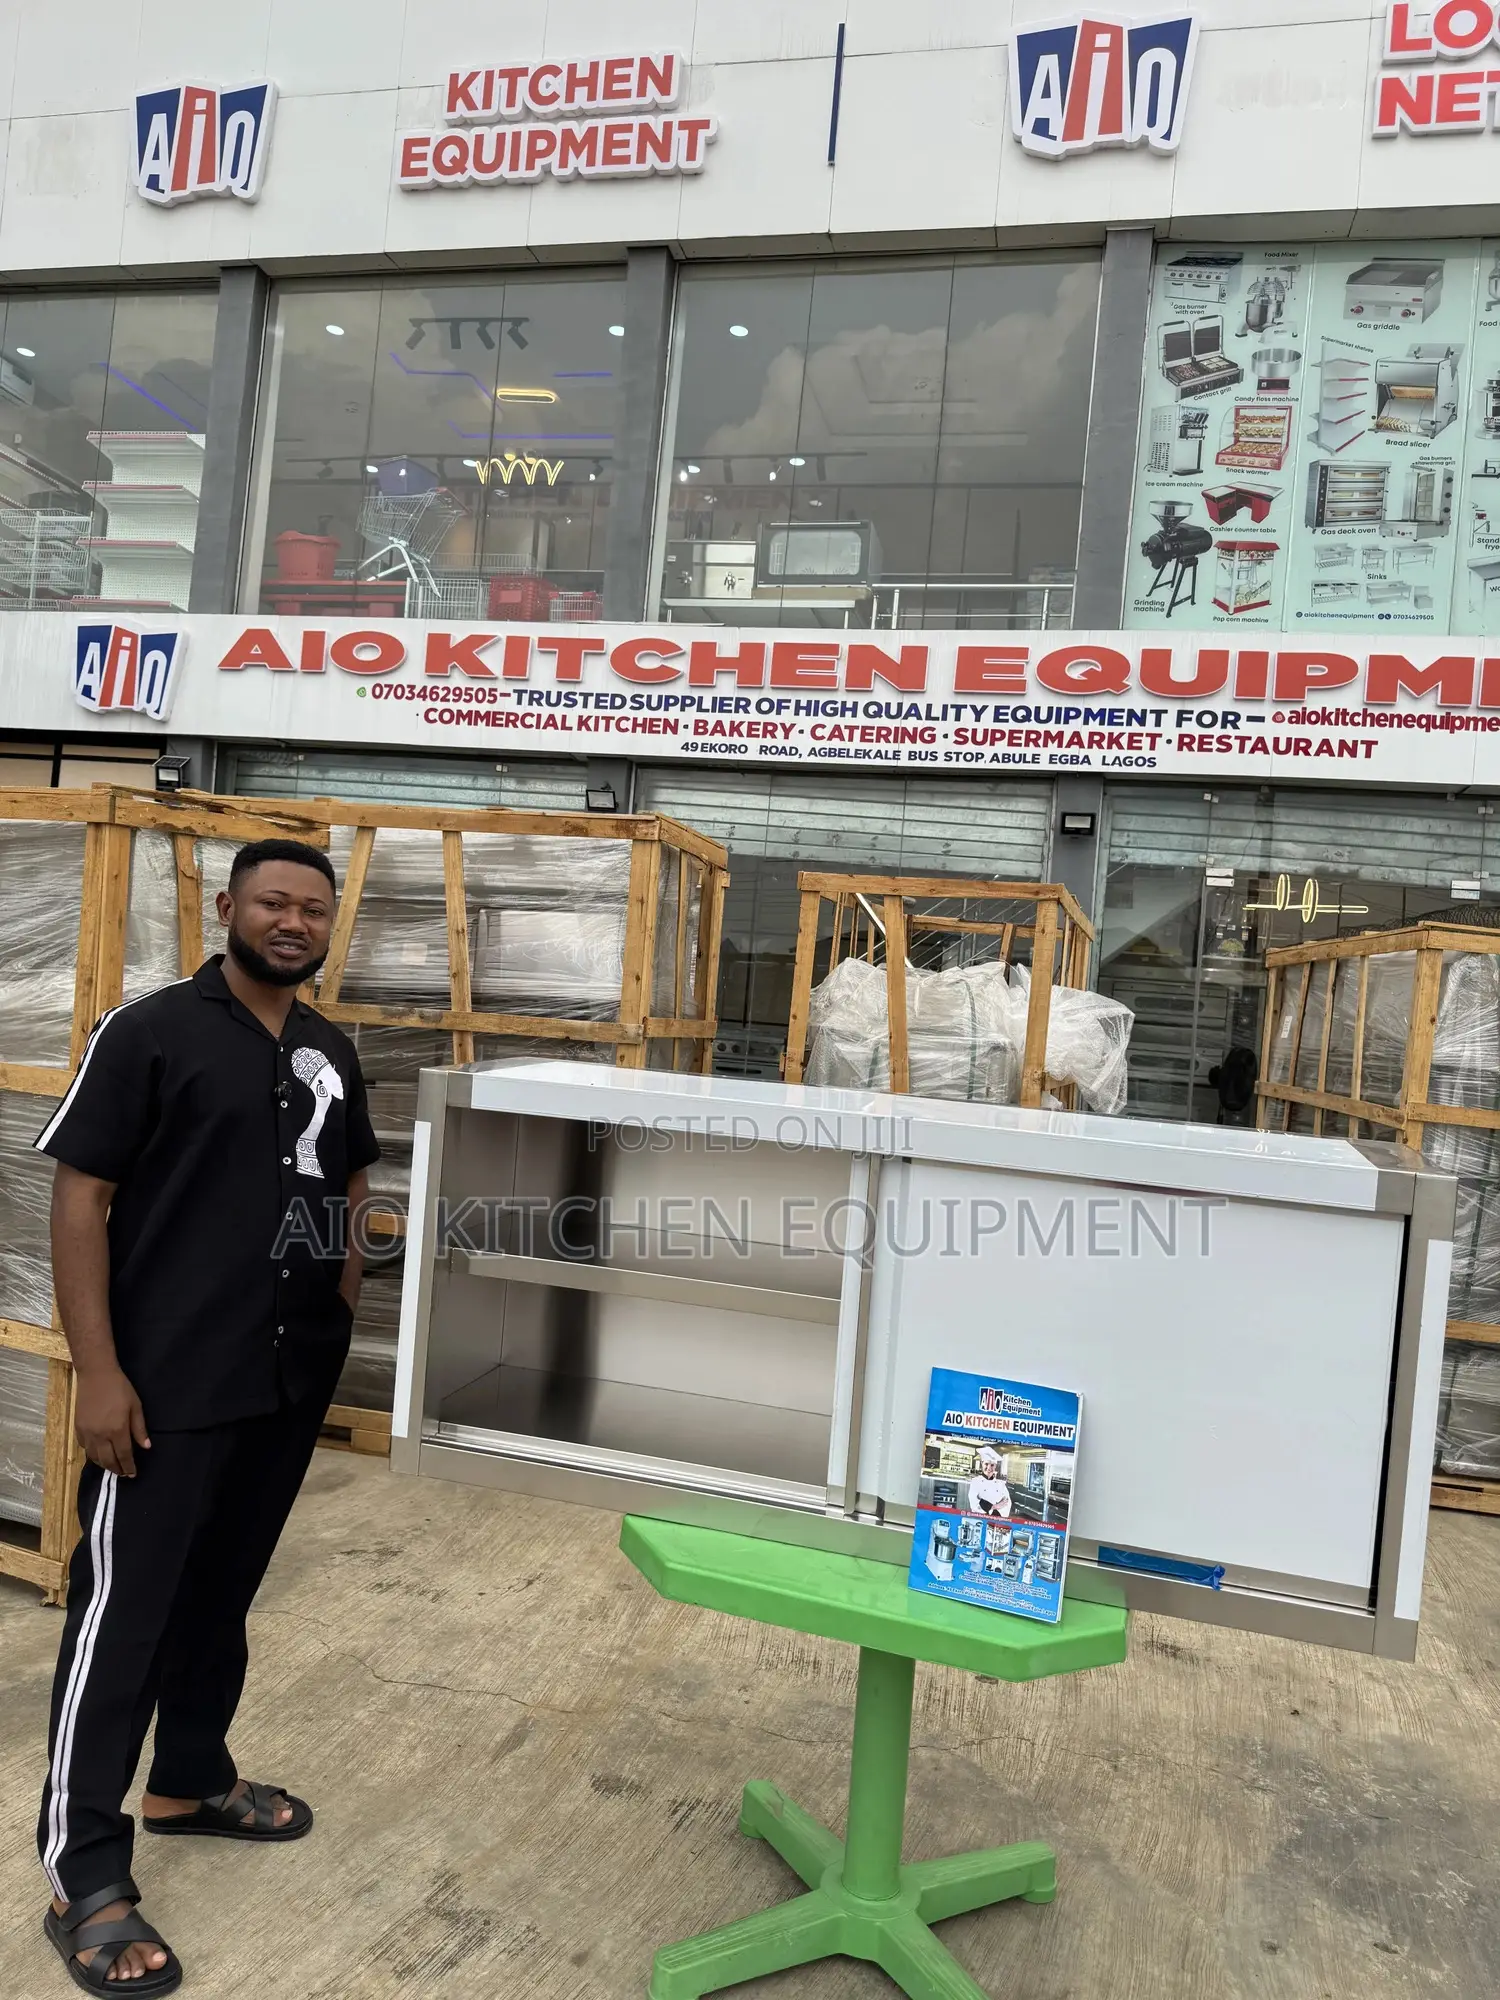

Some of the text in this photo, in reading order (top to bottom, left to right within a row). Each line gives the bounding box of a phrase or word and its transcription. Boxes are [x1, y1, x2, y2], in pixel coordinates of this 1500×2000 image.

[1390, 0, 1500, 52] LO
[447, 54, 676, 113] KITCHEN
[400, 119, 712, 179] EQUIPMENT
[1373, 323, 1400, 331] griddle
[1193, 386, 1232, 401] Contact grill
[1385, 439, 1431, 448] Bread slicer
[1337, 527, 1356, 535] deck
[1134, 599, 1165, 608] Grinding
[1213, 616, 1225, 624] Pop
[1304, 612, 1375, 620] aiokitchenequipment
[217, 627, 407, 676] AIO
[425, 632, 930, 692] KITCHEN
[629, 693, 750, 716] SUPPLIER
[755, 697, 792, 717] OF
[793, 699, 858, 719] HIGH
[863, 700, 990, 723] QUALITY
[993, 704, 1168, 728] EQUIPMENT
[423, 707, 1379, 759] COMMERCIAL KITCHEN BAKERY CATERING SUPERMARKET RESTAURANT
[681, 741, 699, 753] 49
[700, 742, 749, 755] EKORO
[807, 747, 902, 761] AGBELEKALE
[907, 750, 938, 762] BUS
[989, 752, 1040, 765] ABULE
[1048, 754, 1092, 766] EGBA
[1101, 755, 1157, 768] LAGOS
[1003, 1394, 1031, 1406] Kitchen
[1002, 1403, 1041, 1416] Equipment
[945, 1412, 1074, 1438] AIO KITCHEN EQUIPMENT
